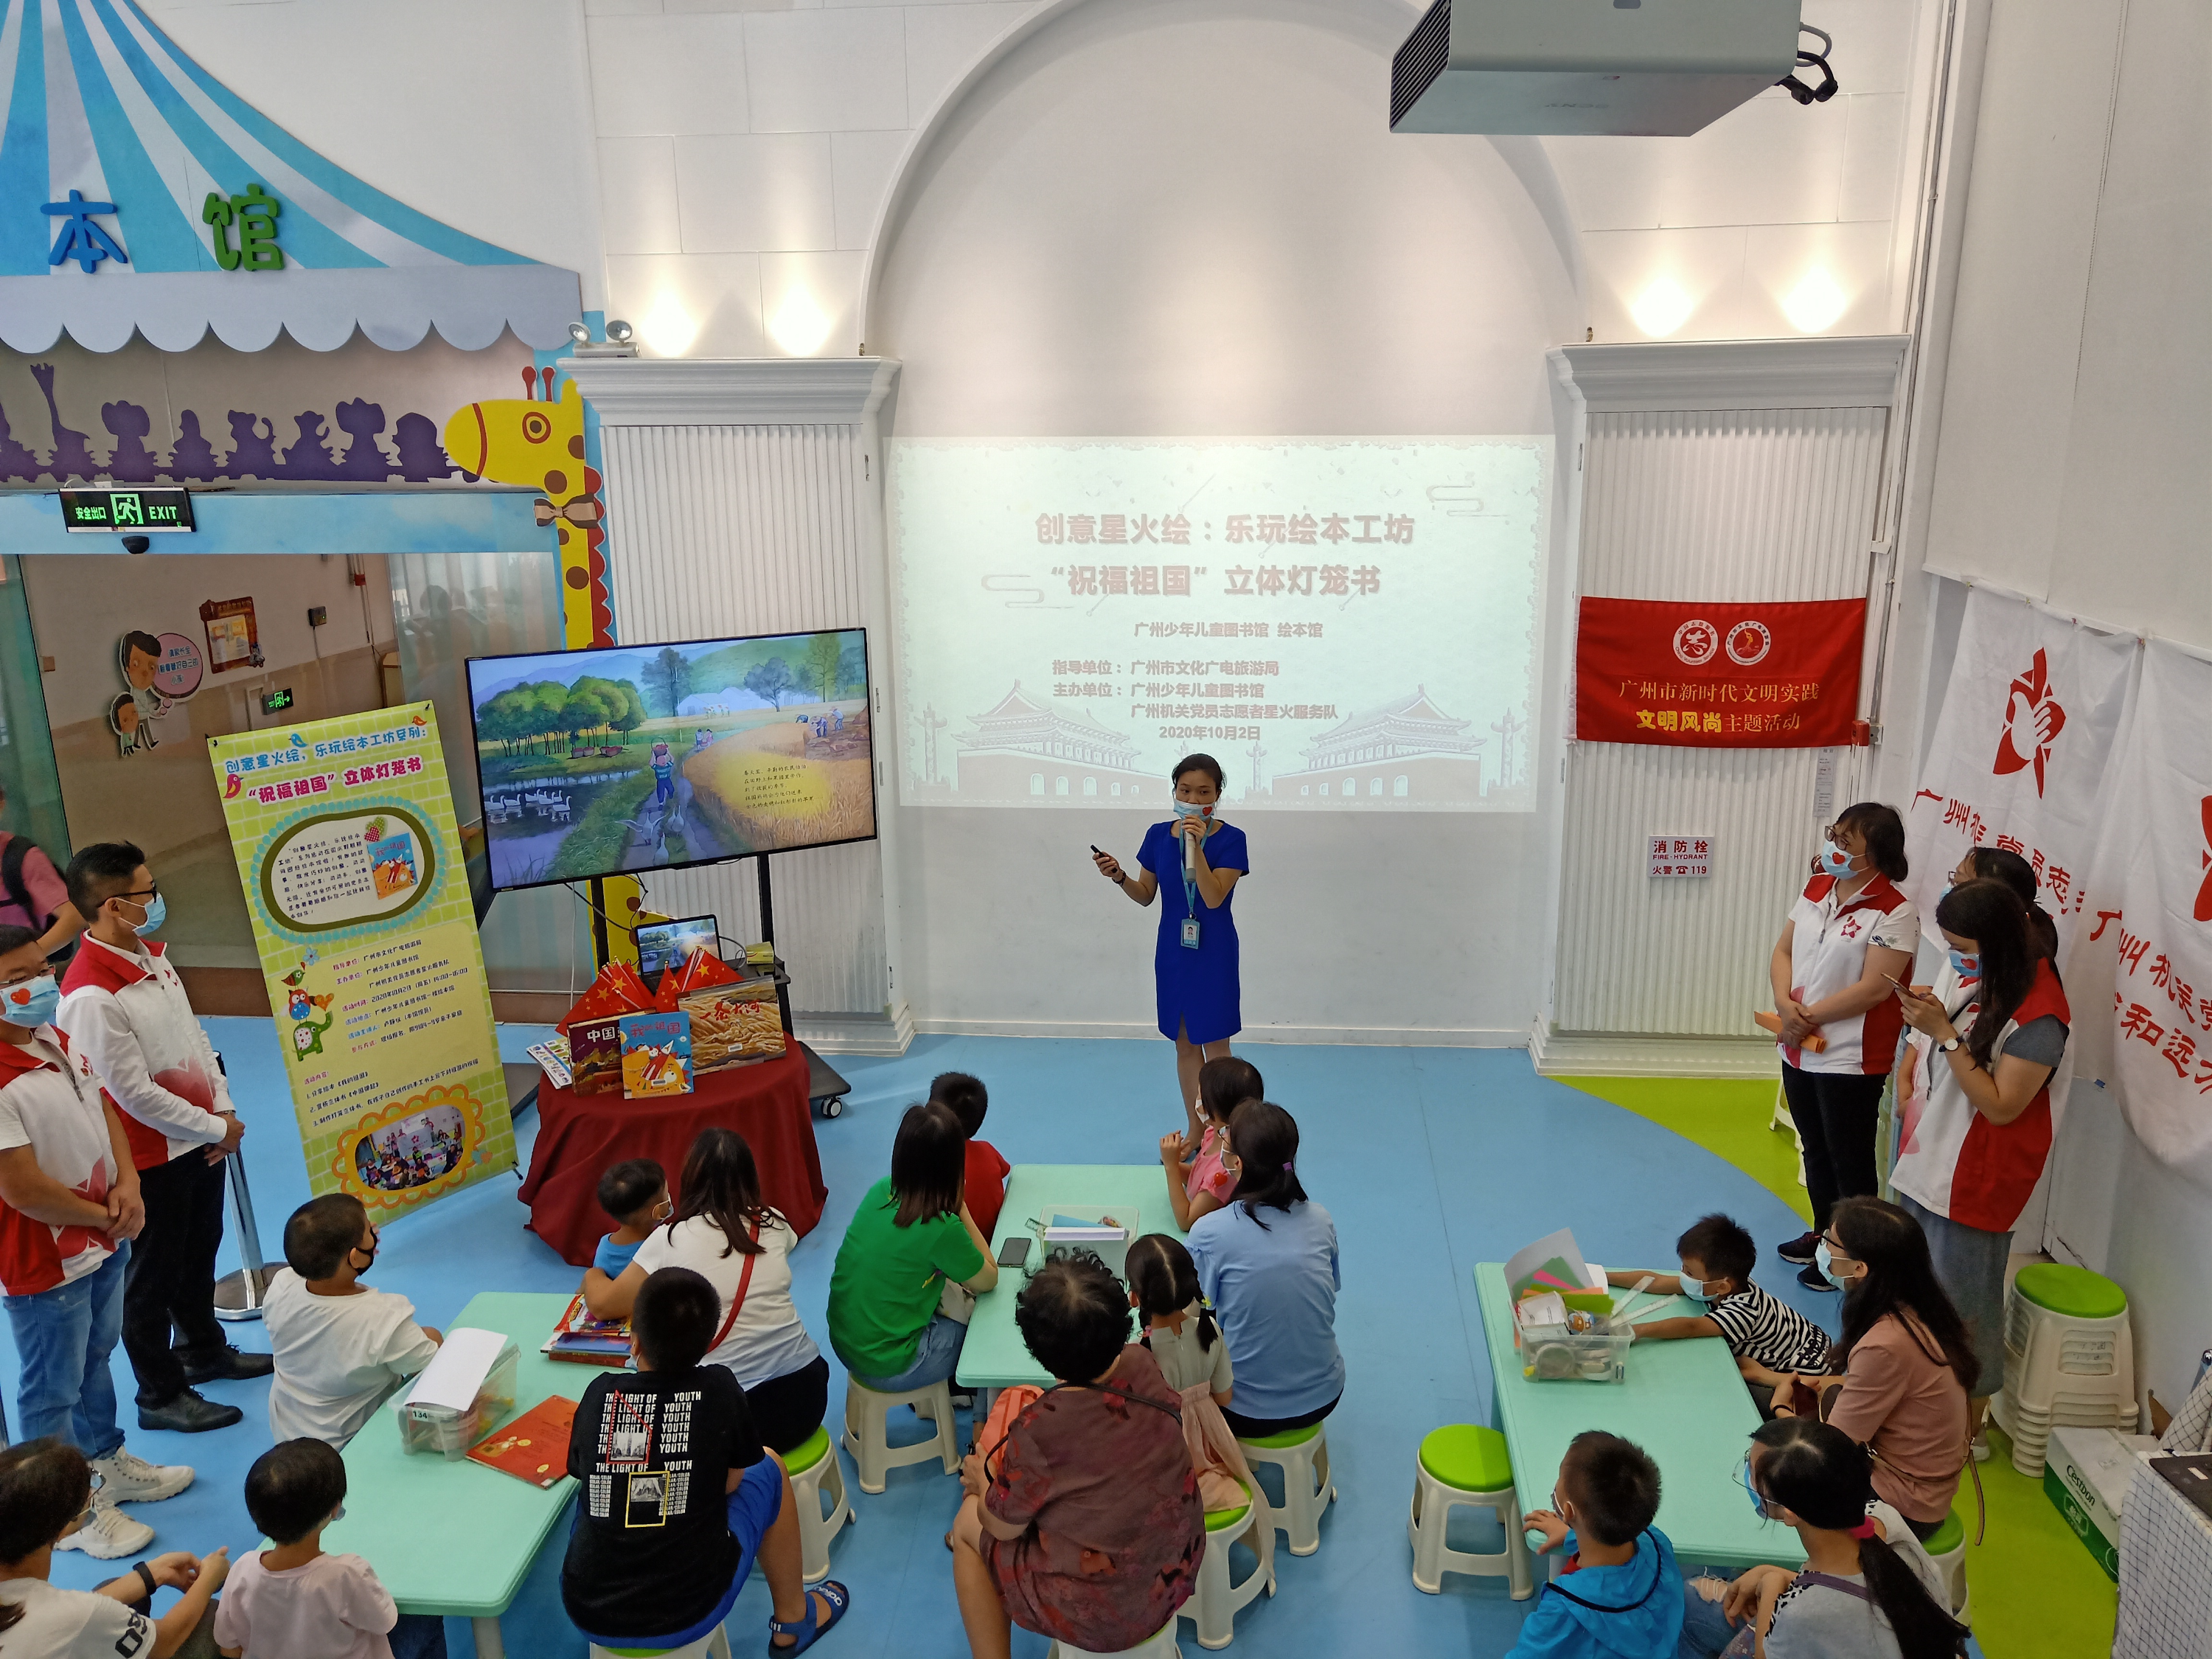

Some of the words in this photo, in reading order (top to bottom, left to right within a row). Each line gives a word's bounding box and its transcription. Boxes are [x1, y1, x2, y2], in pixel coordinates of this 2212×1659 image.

[75, 507, 107, 521] 安全出口
[149, 506, 177, 520] EXIT
[1618, 679, 1820, 703] 广州市新时代文明实践
[1636, 709, 1801, 733] 文明风尚主题活动
[1159, 725, 1262, 740] 2020年10月2日
[1654, 840, 1708, 853] 消防栓
[1652, 866, 1672, 874] 火警
[1691, 866, 1707, 874] 119
[700, 999, 760, 1021] 一条大河
[587, 1026, 620, 1043] 中国
[620, 1394, 645, 1403] LIGHT
[674, 1391, 701, 1402] YOUTH
[619, 1404, 644, 1413] LIGHT
[664, 1402, 692, 1413] YOUTH
[413, 1410, 428, 1419] 134
[617, 1413, 642, 1423] LIGHT
[663, 1412, 691, 1423] YOUTH
[616, 1424, 641, 1433] LIGHT
[662, 1422, 690, 1433] YOUTH
[661, 1432, 689, 1443] YOUTH
[659, 1442, 688, 1454] YOUTH
[596, 1462, 609, 1472] THE
[611, 1463, 636, 1473] LIGHT
[637, 1463, 648, 1472] OF
[664, 1460, 692, 1471] YOUTH
